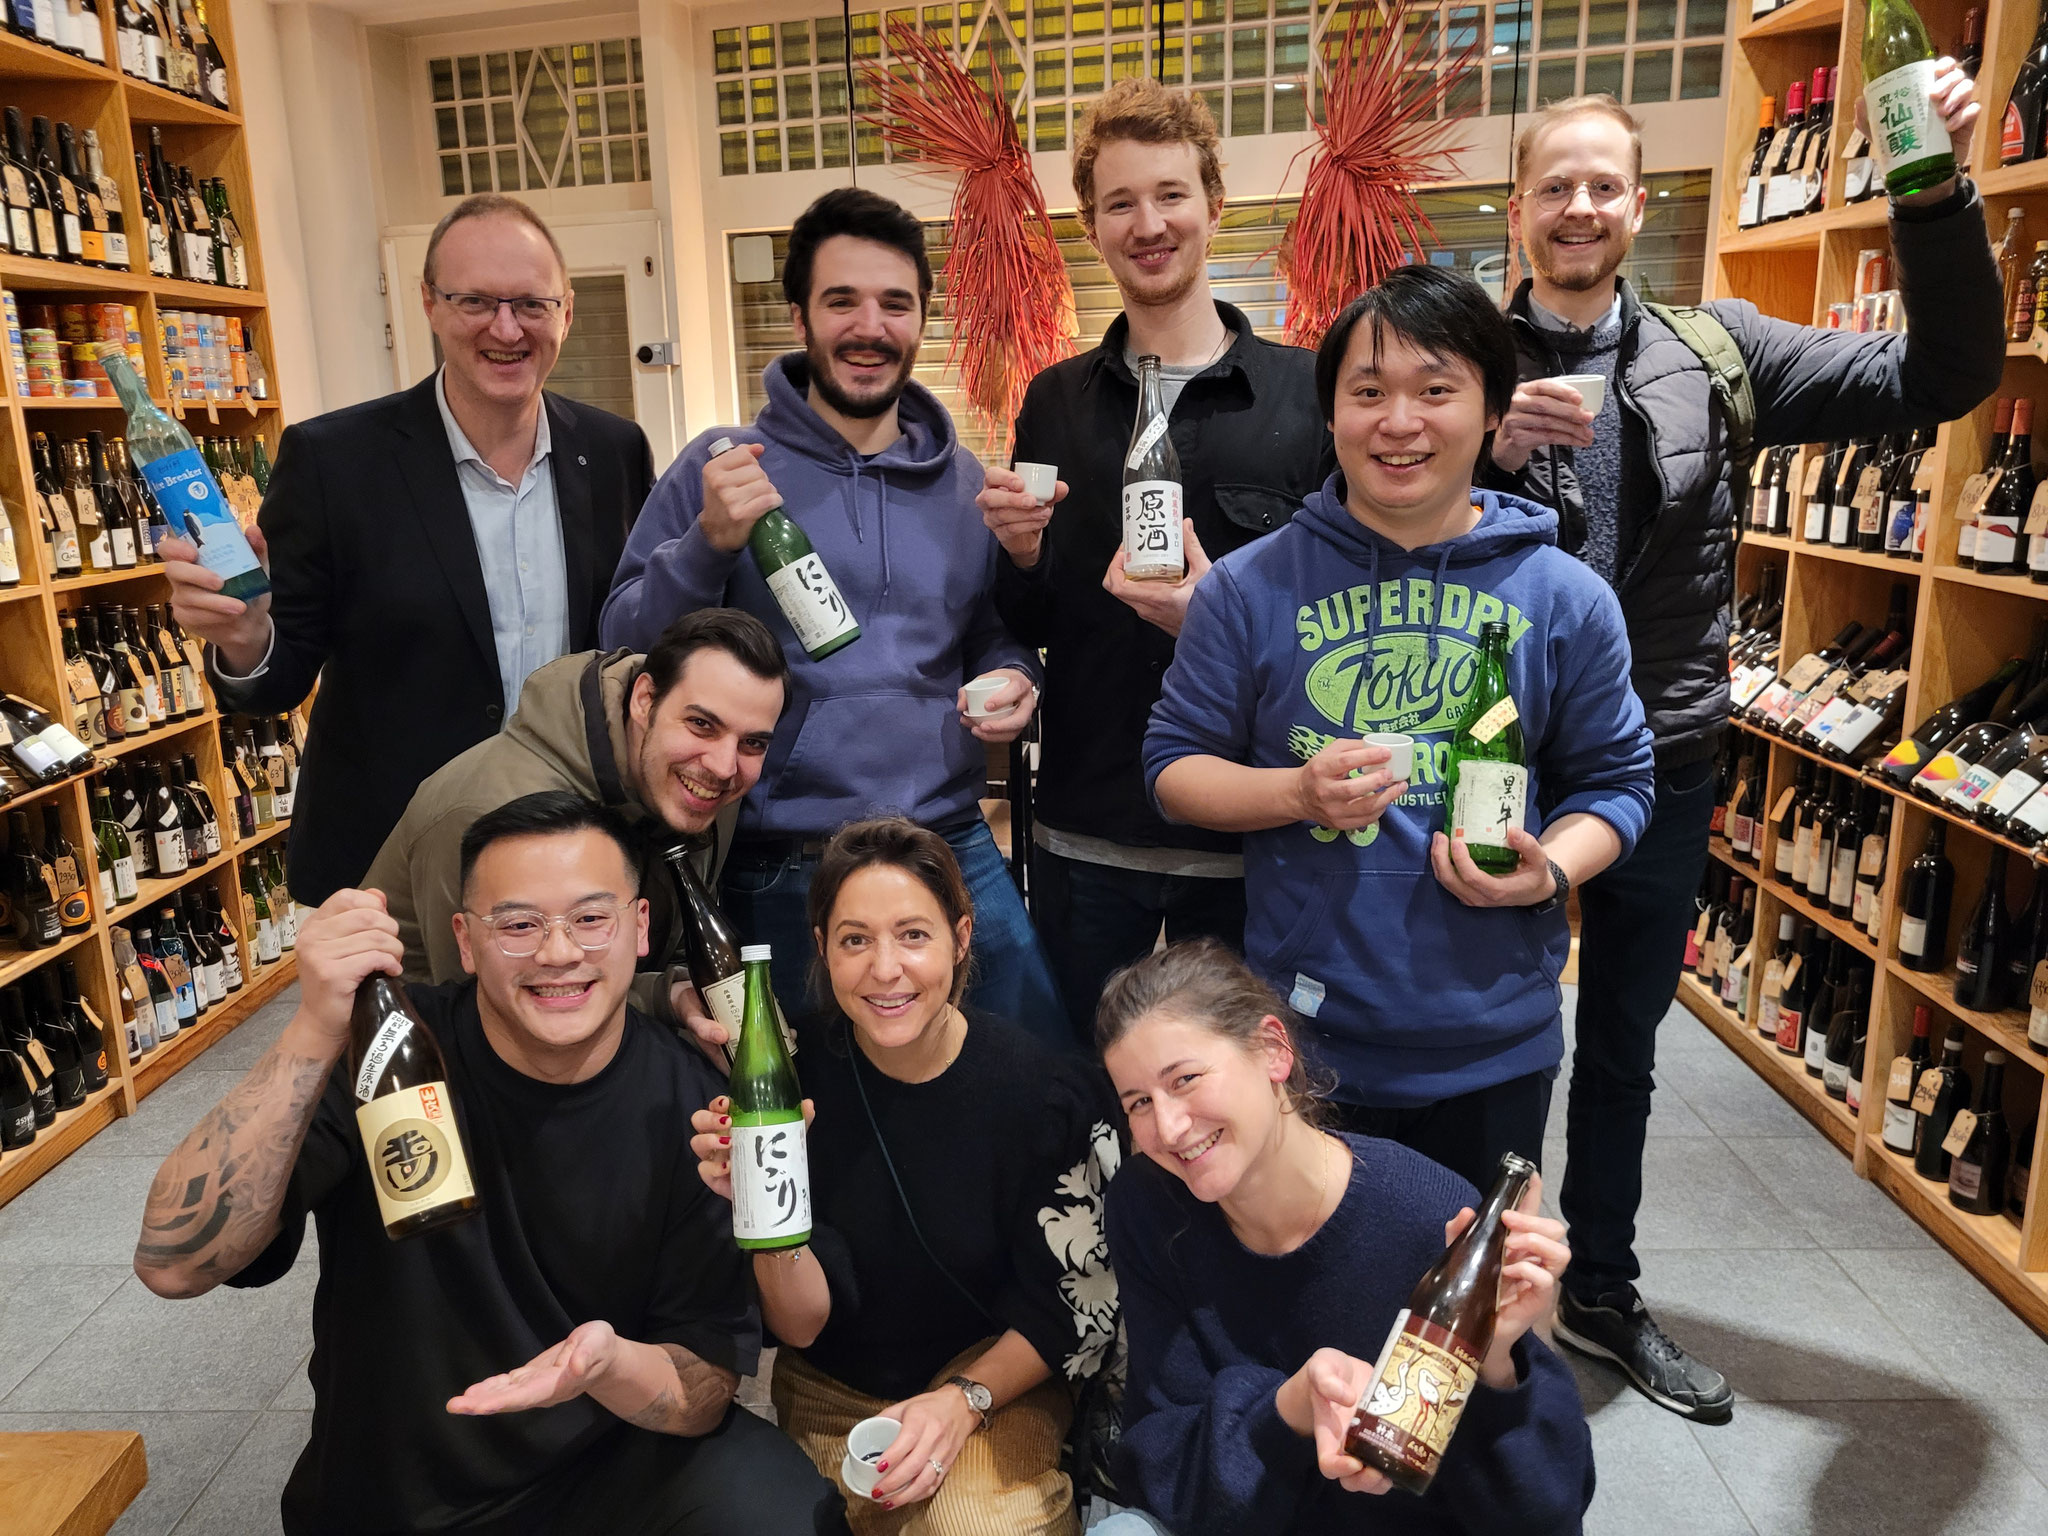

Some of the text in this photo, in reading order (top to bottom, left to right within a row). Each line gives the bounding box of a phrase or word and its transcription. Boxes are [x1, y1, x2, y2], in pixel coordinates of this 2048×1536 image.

[163, 468, 203, 487] Breaker
[1135, 489, 1169, 552] 原酒
[795, 560, 847, 626] にごり
[1295, 578, 1535, 654] SUPERDRY
[1336, 648, 1480, 729] Tokyo
[391, 1014, 410, 1027] 2017
[755, 1131, 798, 1229] にごり
